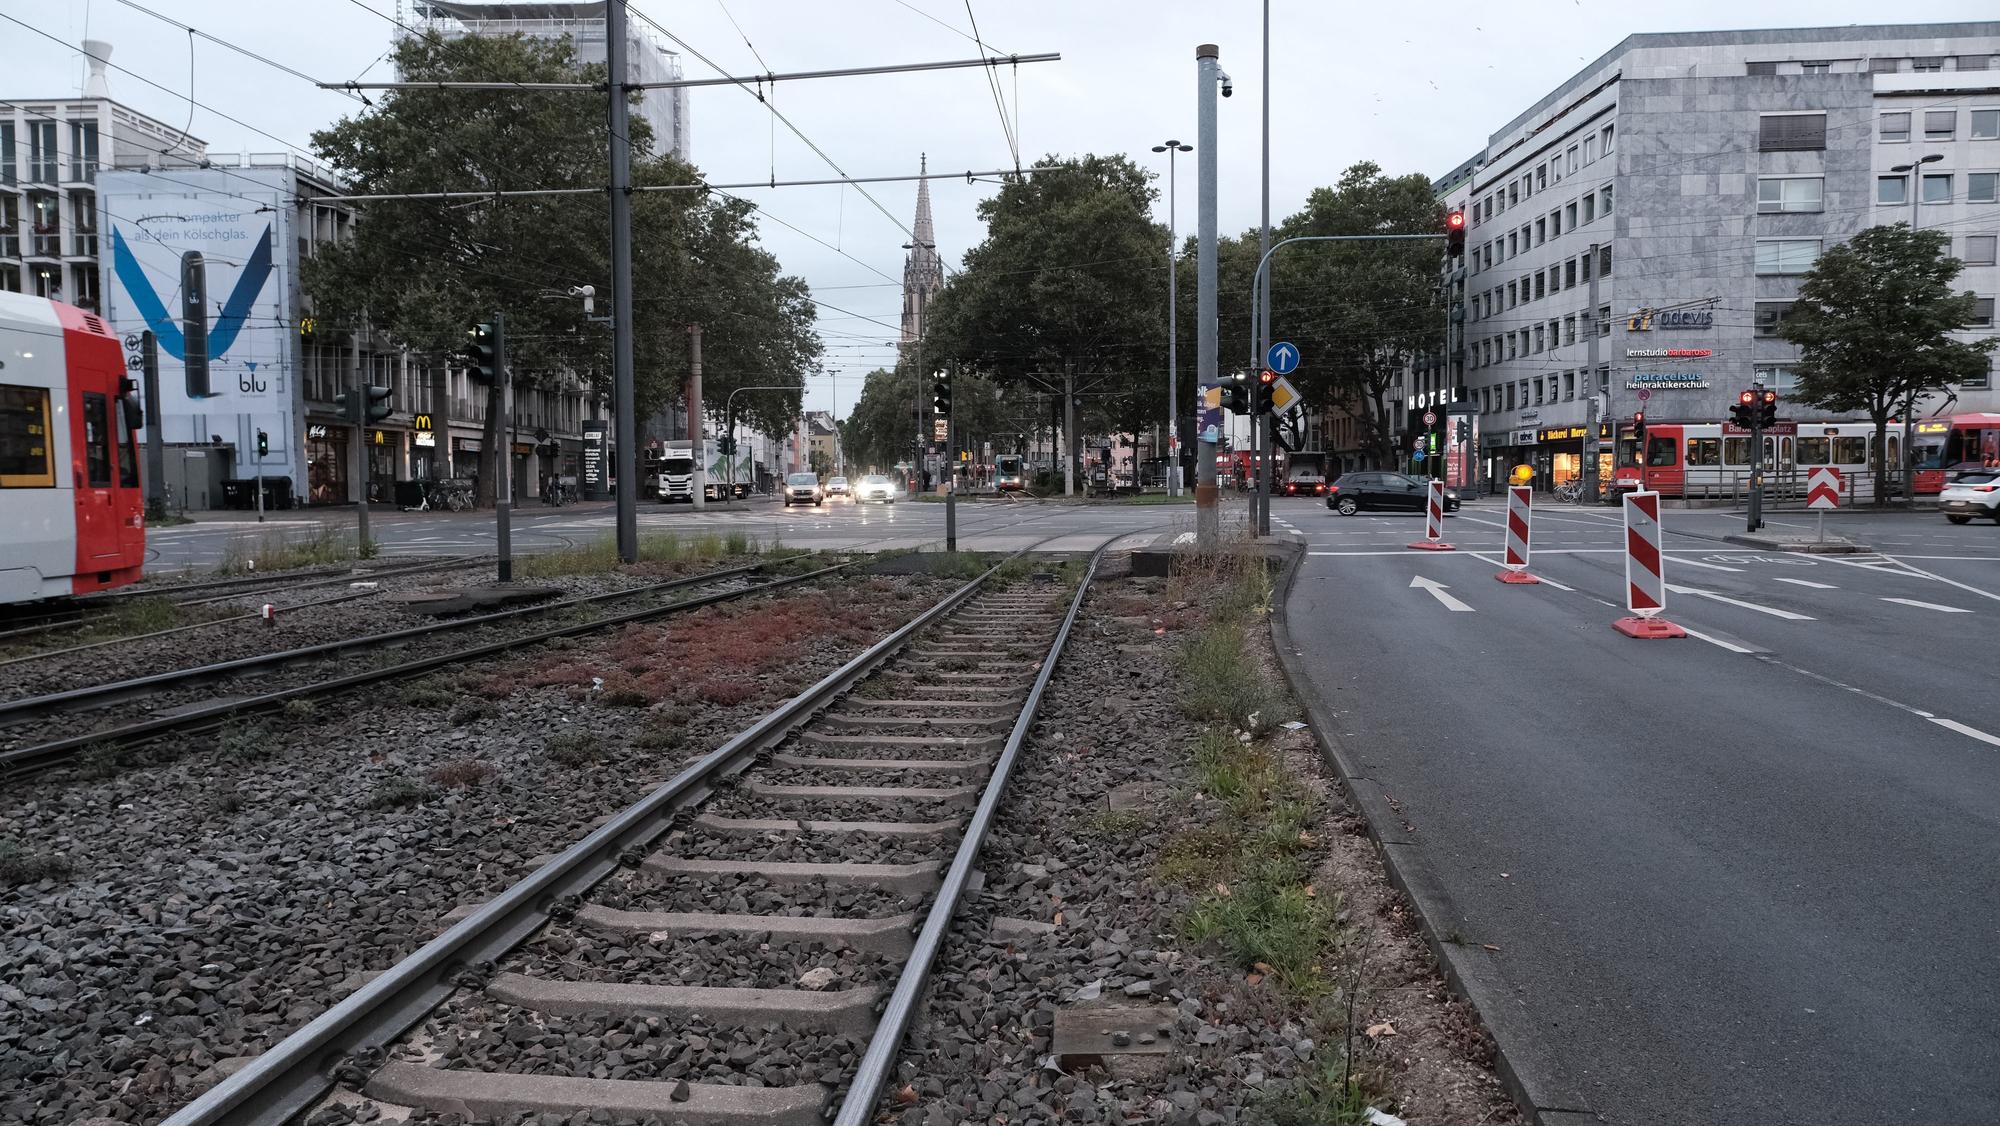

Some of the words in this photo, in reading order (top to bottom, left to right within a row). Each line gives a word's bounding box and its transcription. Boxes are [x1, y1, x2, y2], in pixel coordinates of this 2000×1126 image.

[177, 211, 241, 224] kompakter
[134, 229, 150, 241] als
[154, 229, 180, 240] dein
[183, 228, 249, 241] Kölschglas.
[239, 373, 266, 393] blu
[1634, 371, 1702, 383] paracelsus
[1626, 380, 1710, 389] heilpraktikerschule
[1408, 387, 1458, 410] HOTEL
